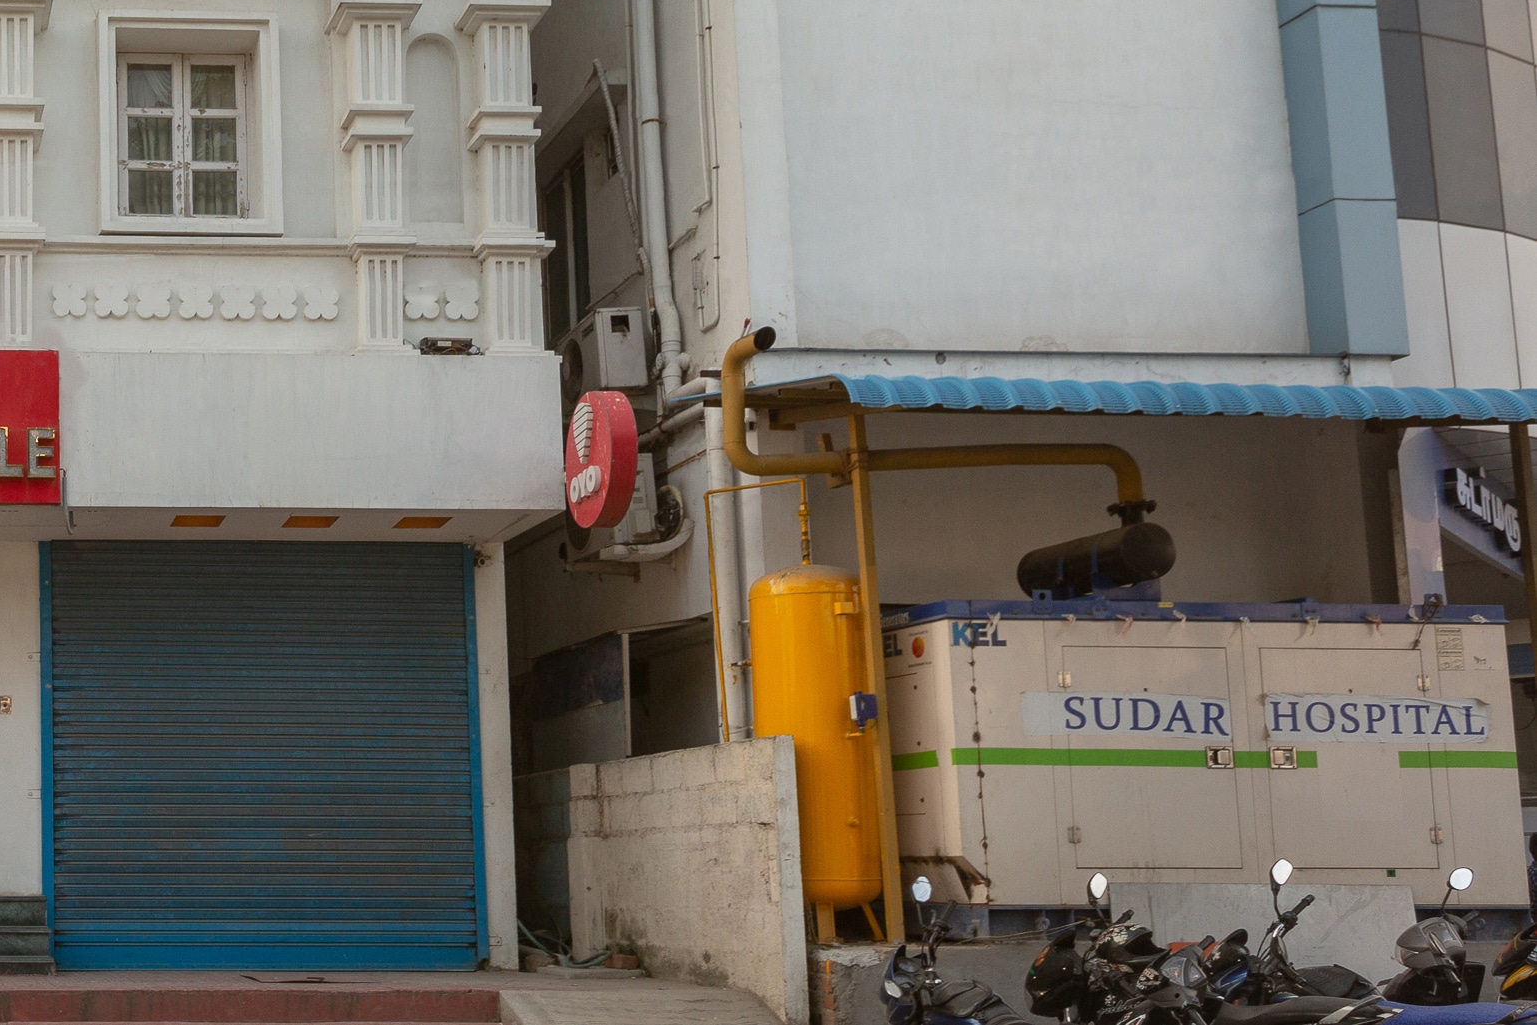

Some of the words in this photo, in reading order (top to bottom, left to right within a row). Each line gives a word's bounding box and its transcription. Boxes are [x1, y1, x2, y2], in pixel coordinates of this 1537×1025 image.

[570, 465, 601, 504] OYO
[951, 621, 1007, 647] KEL
[1064, 696, 1229, 736] SUDAR
[1271, 701, 1485, 736] HOSPITAL
